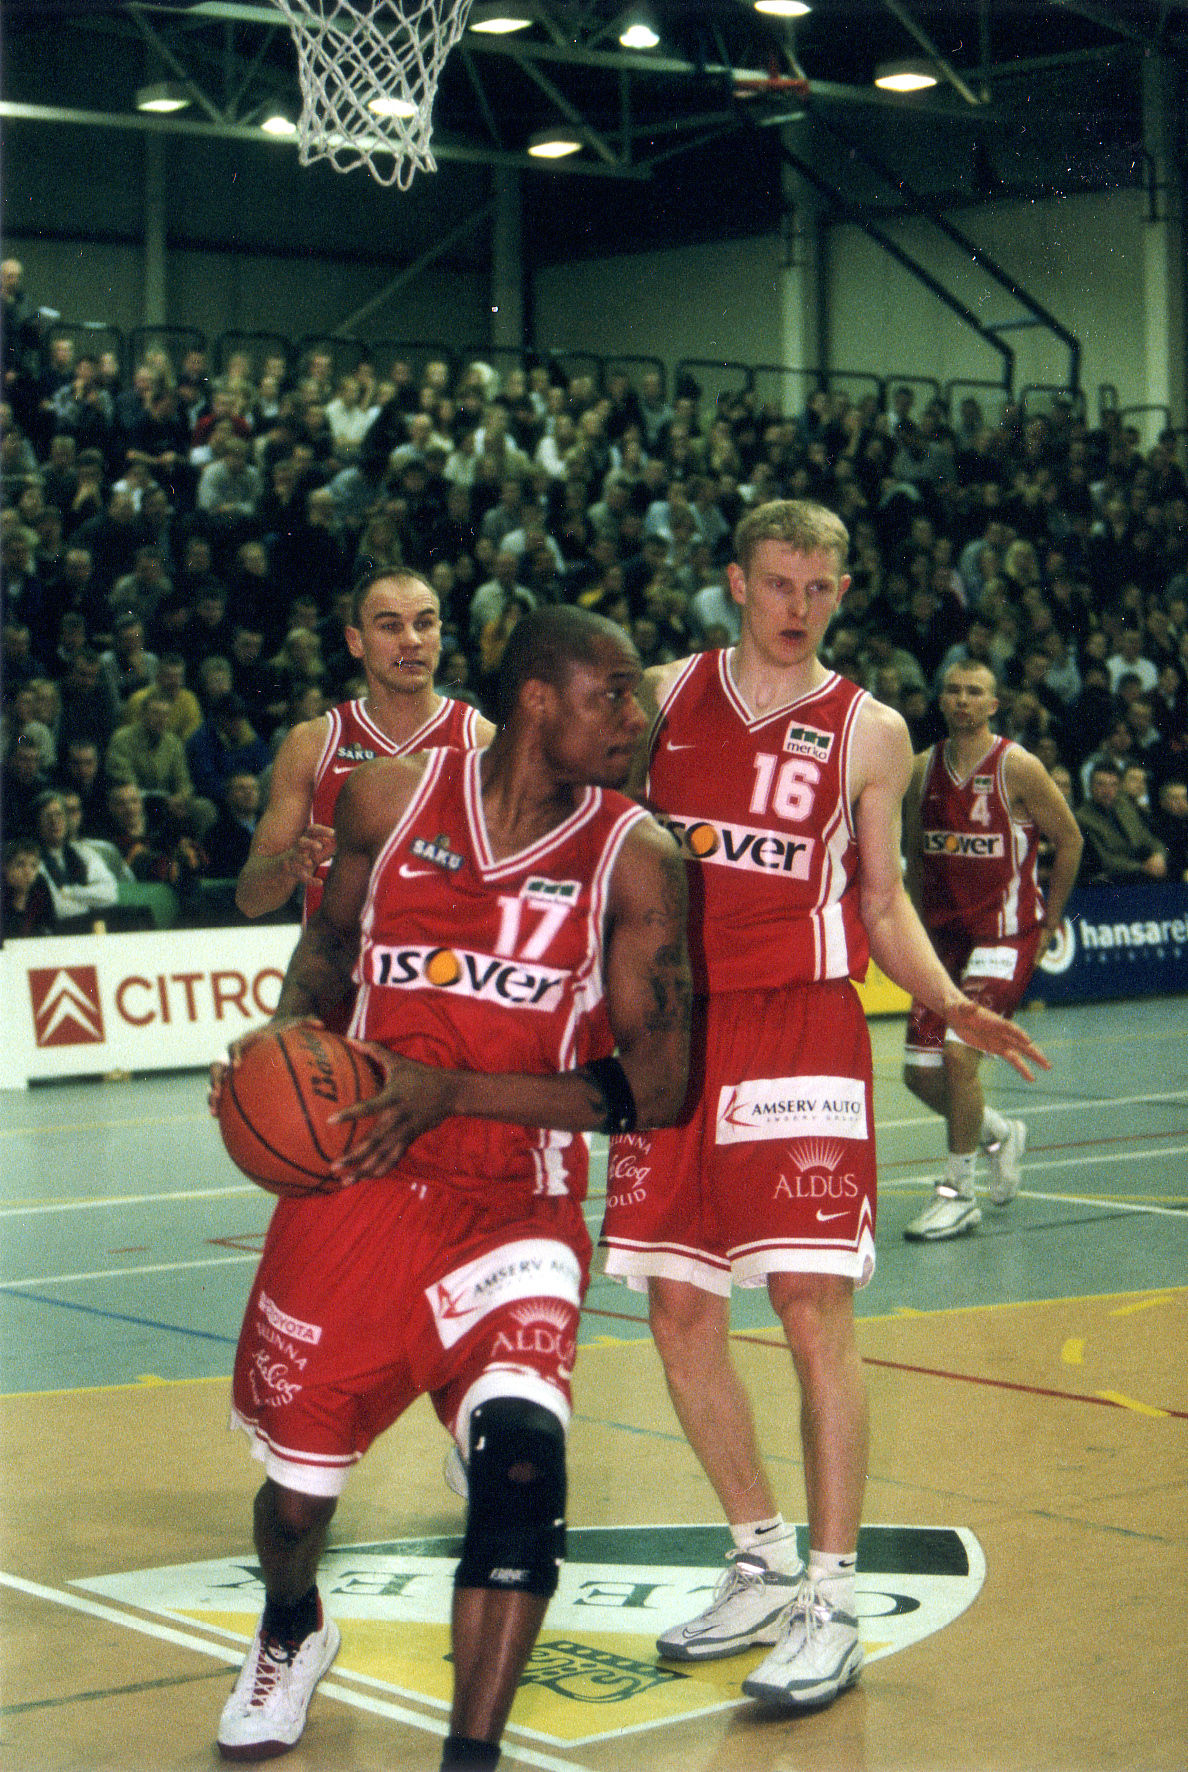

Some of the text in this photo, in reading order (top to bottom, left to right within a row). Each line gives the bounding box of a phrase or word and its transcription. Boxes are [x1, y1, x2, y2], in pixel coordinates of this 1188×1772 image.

[337, 746, 375, 760] SAKU
[787, 740, 828, 760] merko
[749, 752, 821, 822] 16
[969, 794, 992, 827] 4
[412, 838, 463, 871] SAKU
[495, 896, 571, 960] 17
[752, 1099, 861, 1116] AMSERV AUTO
[774, 1173, 858, 1199] ALDUS
[490, 1329, 576, 1361] ALDU
